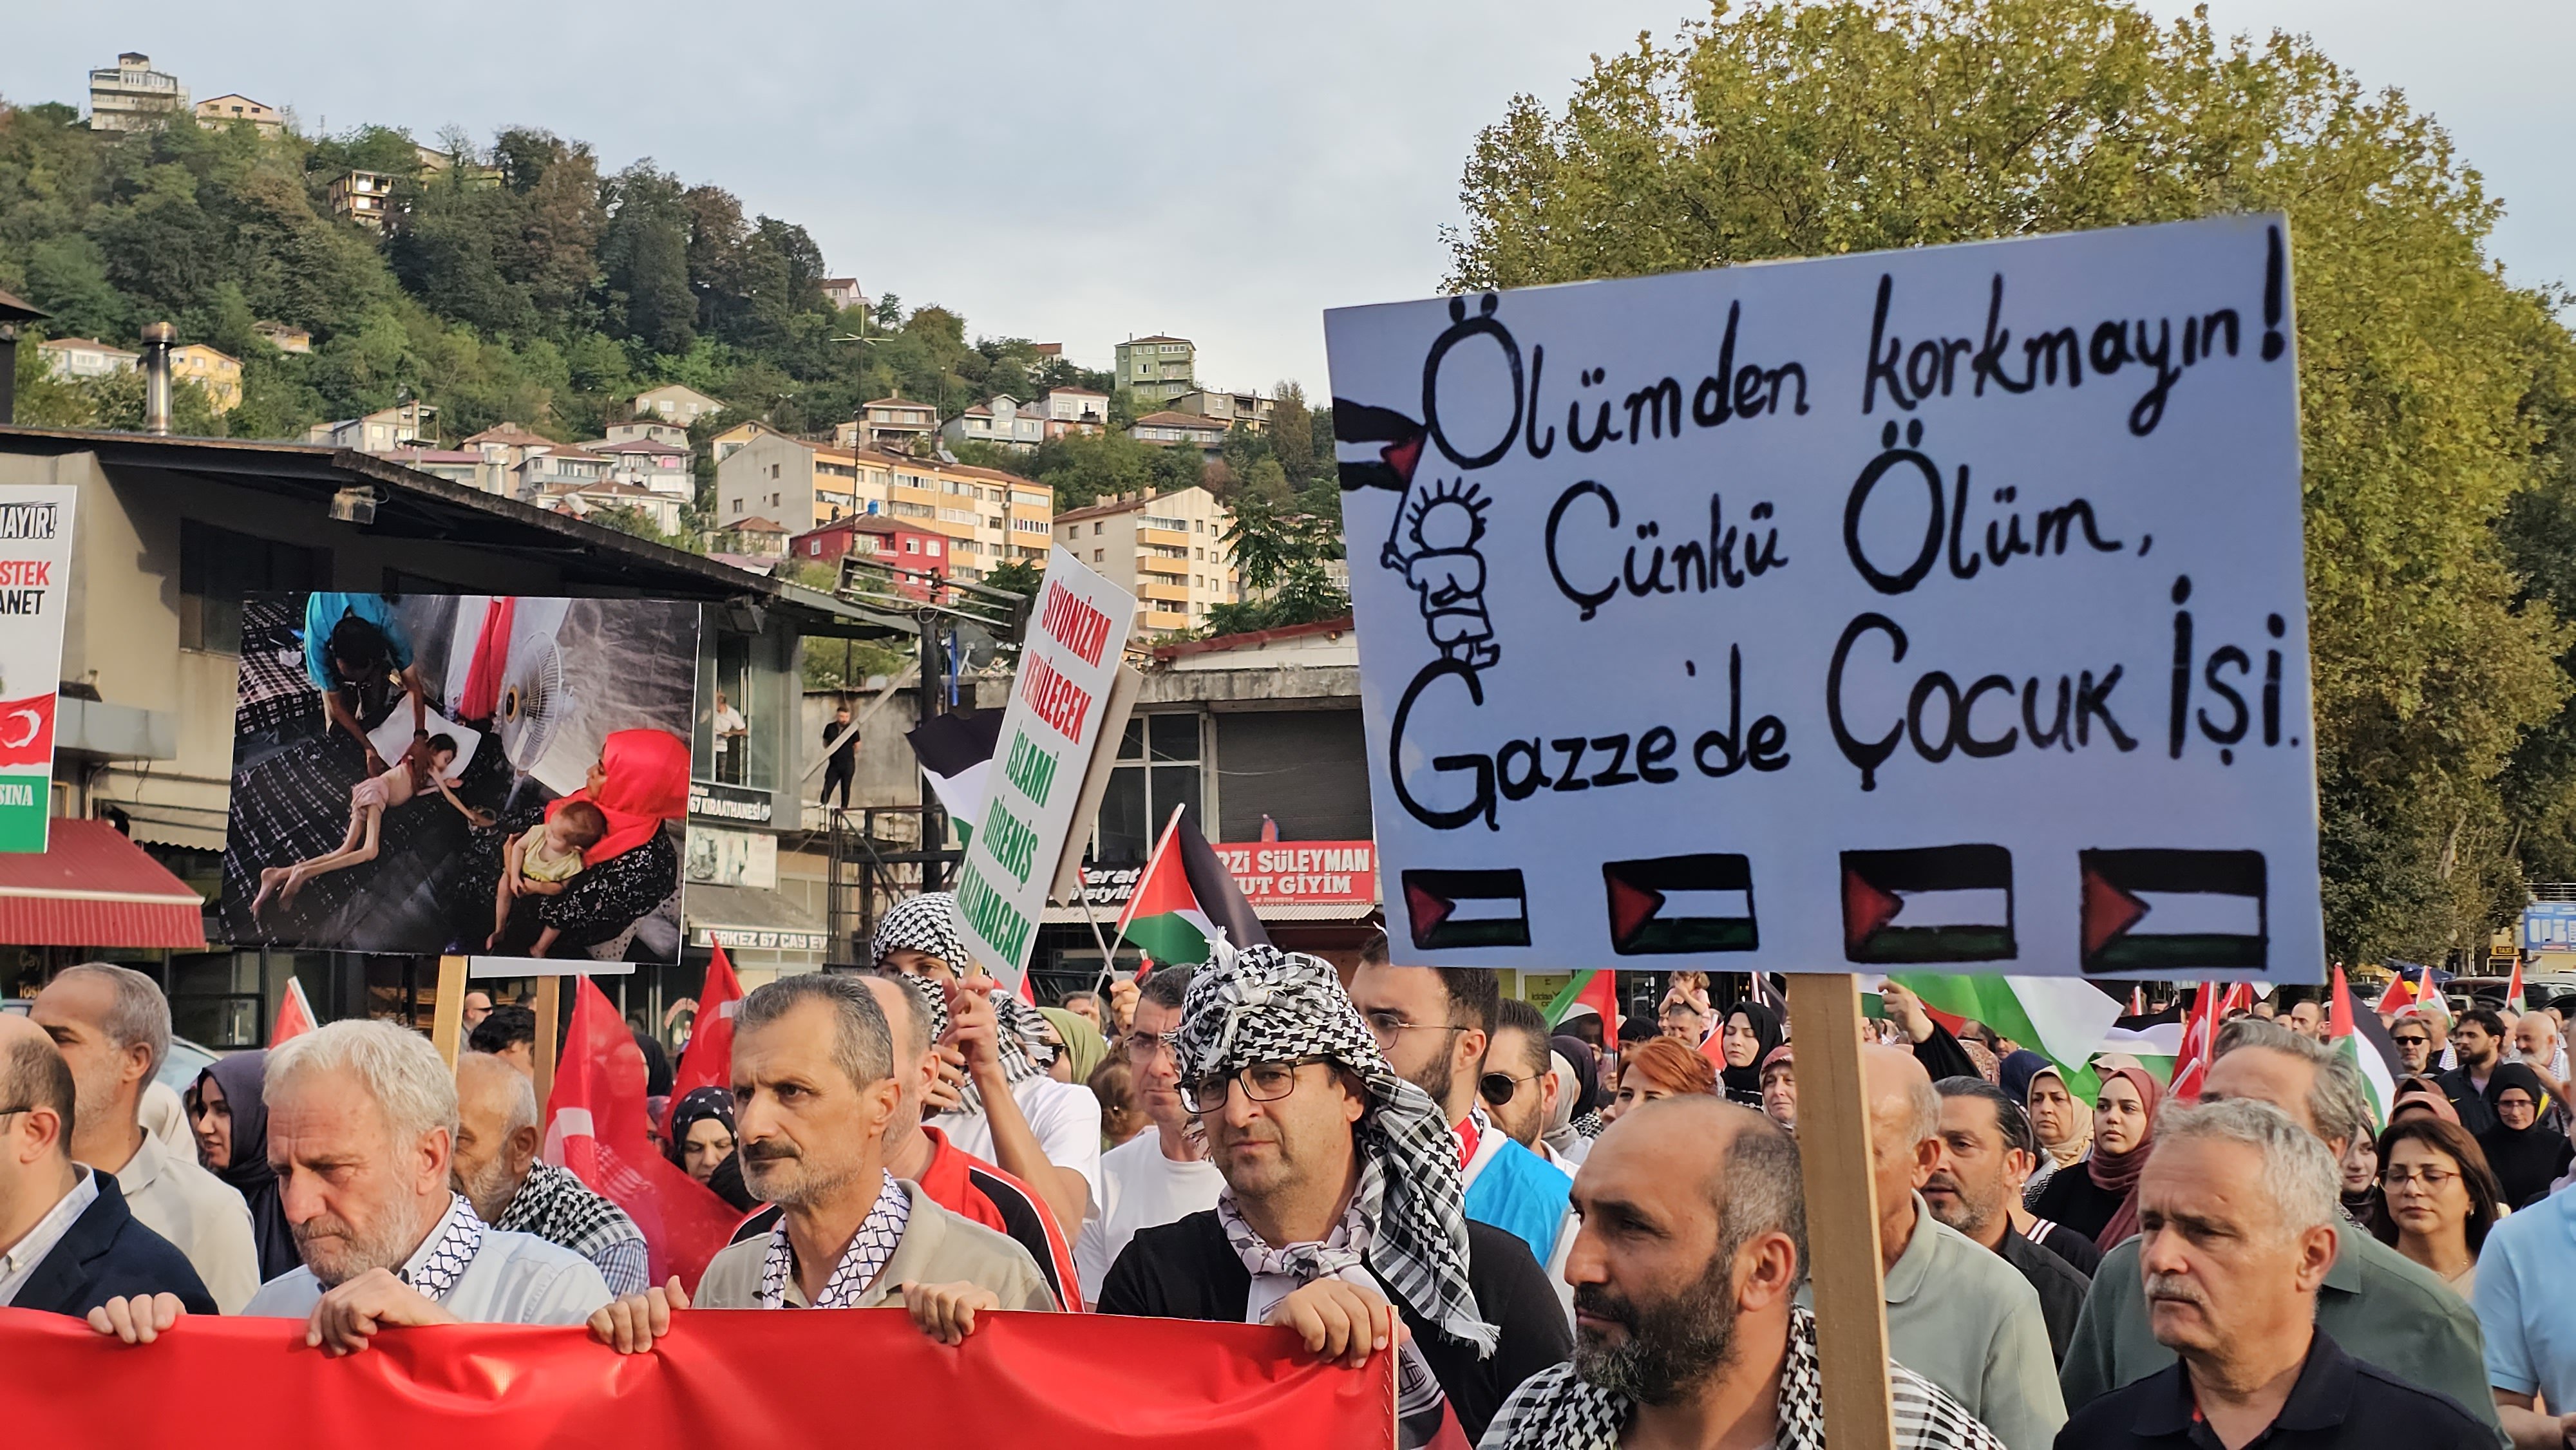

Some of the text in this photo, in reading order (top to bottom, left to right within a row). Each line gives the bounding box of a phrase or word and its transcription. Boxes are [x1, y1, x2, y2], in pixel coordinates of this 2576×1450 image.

[1423, 225, 2285, 470] Ölümden korkmayın!
[1544, 418, 2153, 622] Çünkü Ölüm,
[1041, 575, 1112, 668] SİYONİZM
[1021, 648, 1092, 745] YENİLECEK
[1389, 642, 1791, 831] Gazze'de
[689, 795, 701, 813] 67
[982, 794, 1039, 893] DİRENİŞ
[1233, 874, 1352, 896] UT GİYİM
[1257, 848, 1370, 873] SÜLEYMAN
[759, 932, 778, 947] 67
[956, 856, 1031, 971] KAZANACAK
